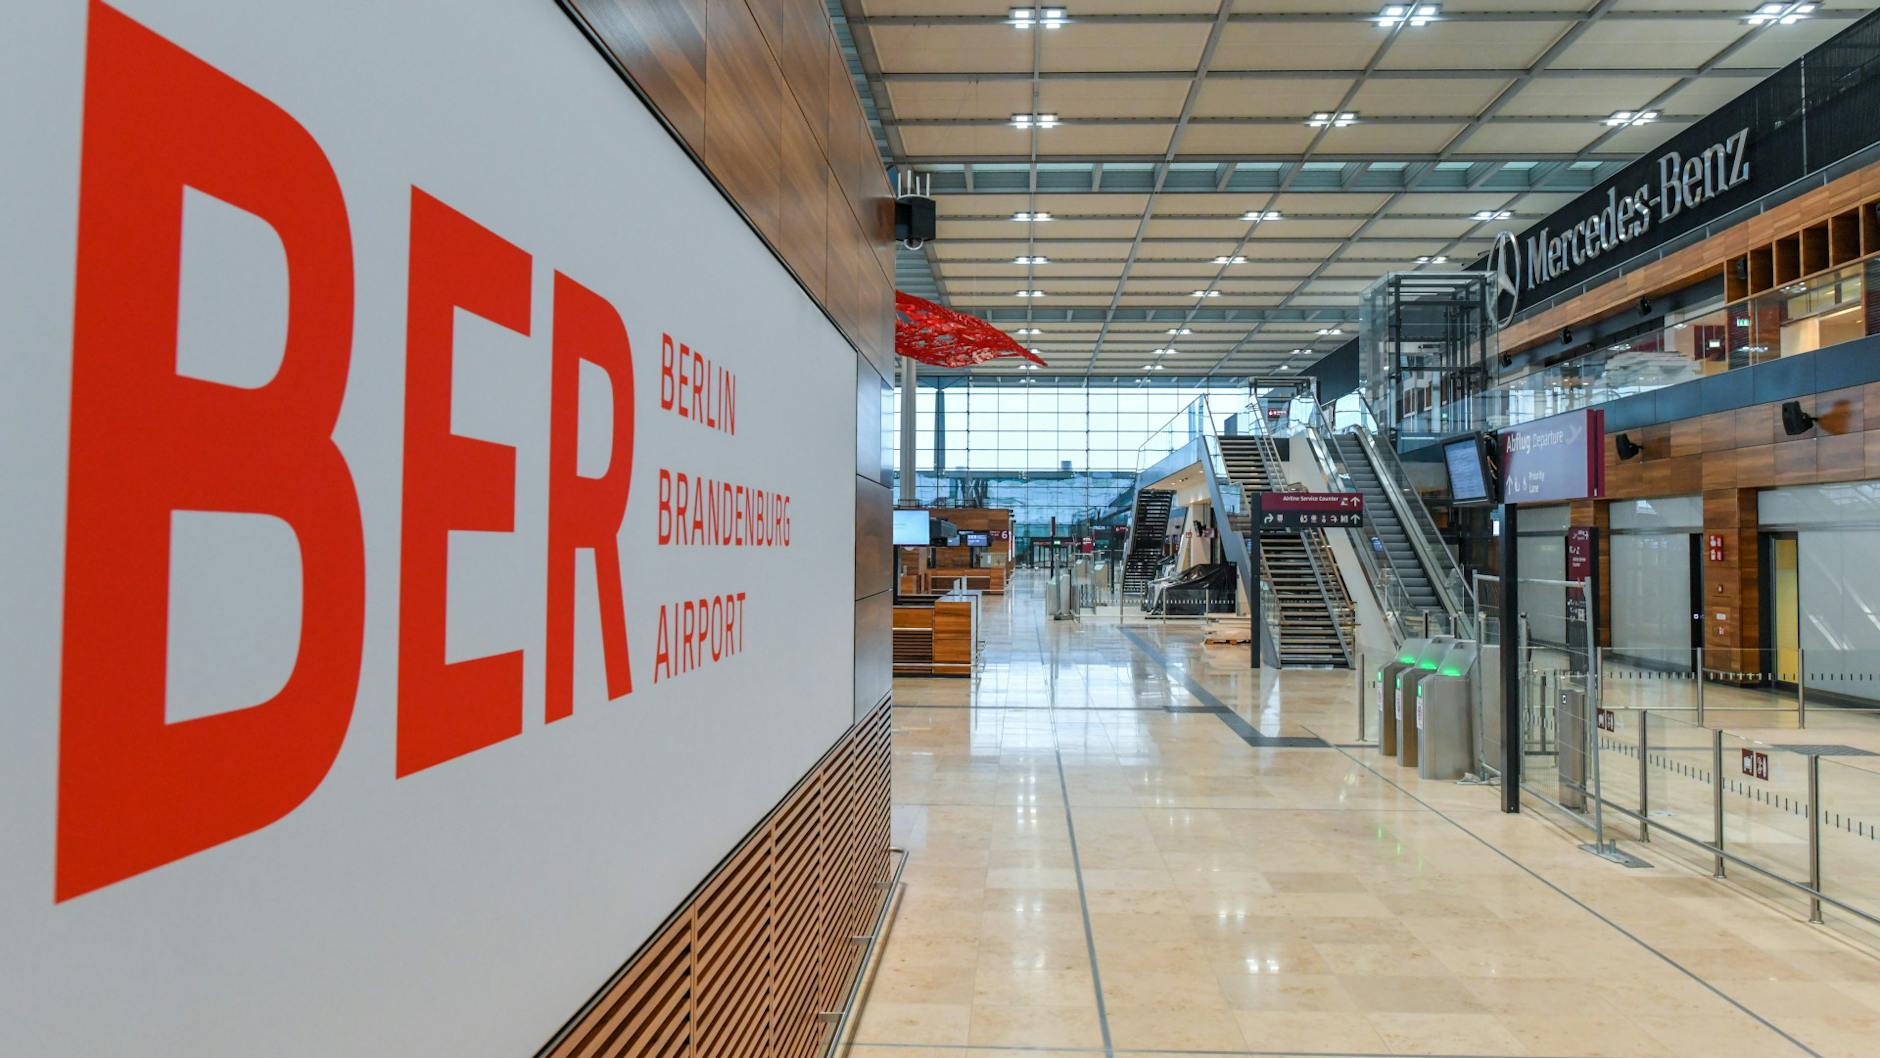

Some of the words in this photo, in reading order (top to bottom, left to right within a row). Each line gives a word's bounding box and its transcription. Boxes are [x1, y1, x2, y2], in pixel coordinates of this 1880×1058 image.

[1527, 127, 1749, 289] Mercedes-Benz
[661, 332, 736, 436] BERLIN
[55, 0, 634, 904] BER
[1506, 432, 1531, 455] Abflug
[658, 468, 791, 547] BRANDENBURG
[1001, 530, 1008, 540] 6
[654, 591, 746, 684] AIRPORT
